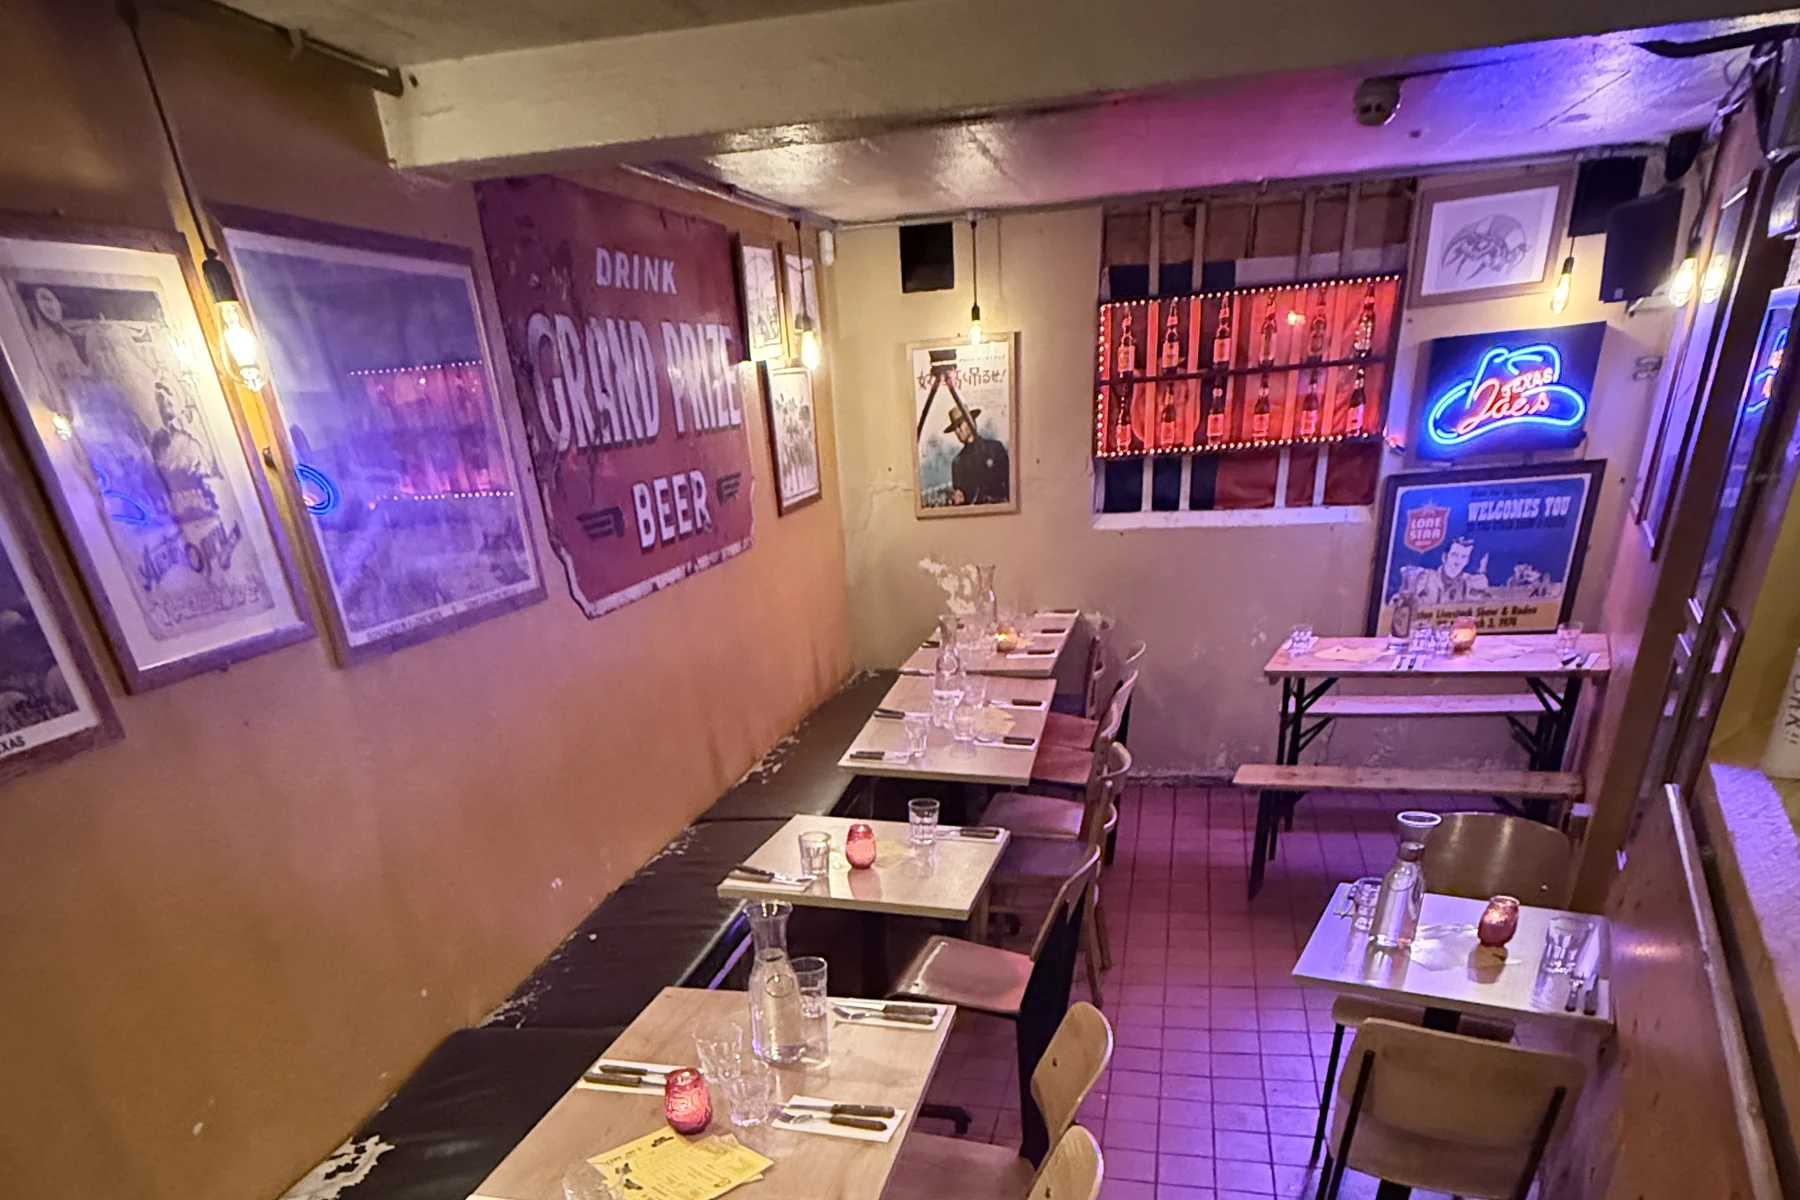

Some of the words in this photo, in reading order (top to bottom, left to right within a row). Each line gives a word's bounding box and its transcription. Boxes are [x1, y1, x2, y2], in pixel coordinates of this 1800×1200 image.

[596, 247, 677, 295] DRINK
[527, 312, 660, 451] GRAND
[661, 321, 741, 433] PRIZE
[1501, 367, 1554, 398] TEXAS
[632, 469, 712, 548] BEER
[1467, 497, 1540, 522] WELCOMES
[1544, 496, 1572, 518] YOU
[1409, 527, 1441, 541] STAR
[1410, 517, 1442, 530] LONE
[1476, 606, 1500, 618] Show
[1511, 605, 1538, 616] Rodeo
[0, 735, 25, 754] XAS
